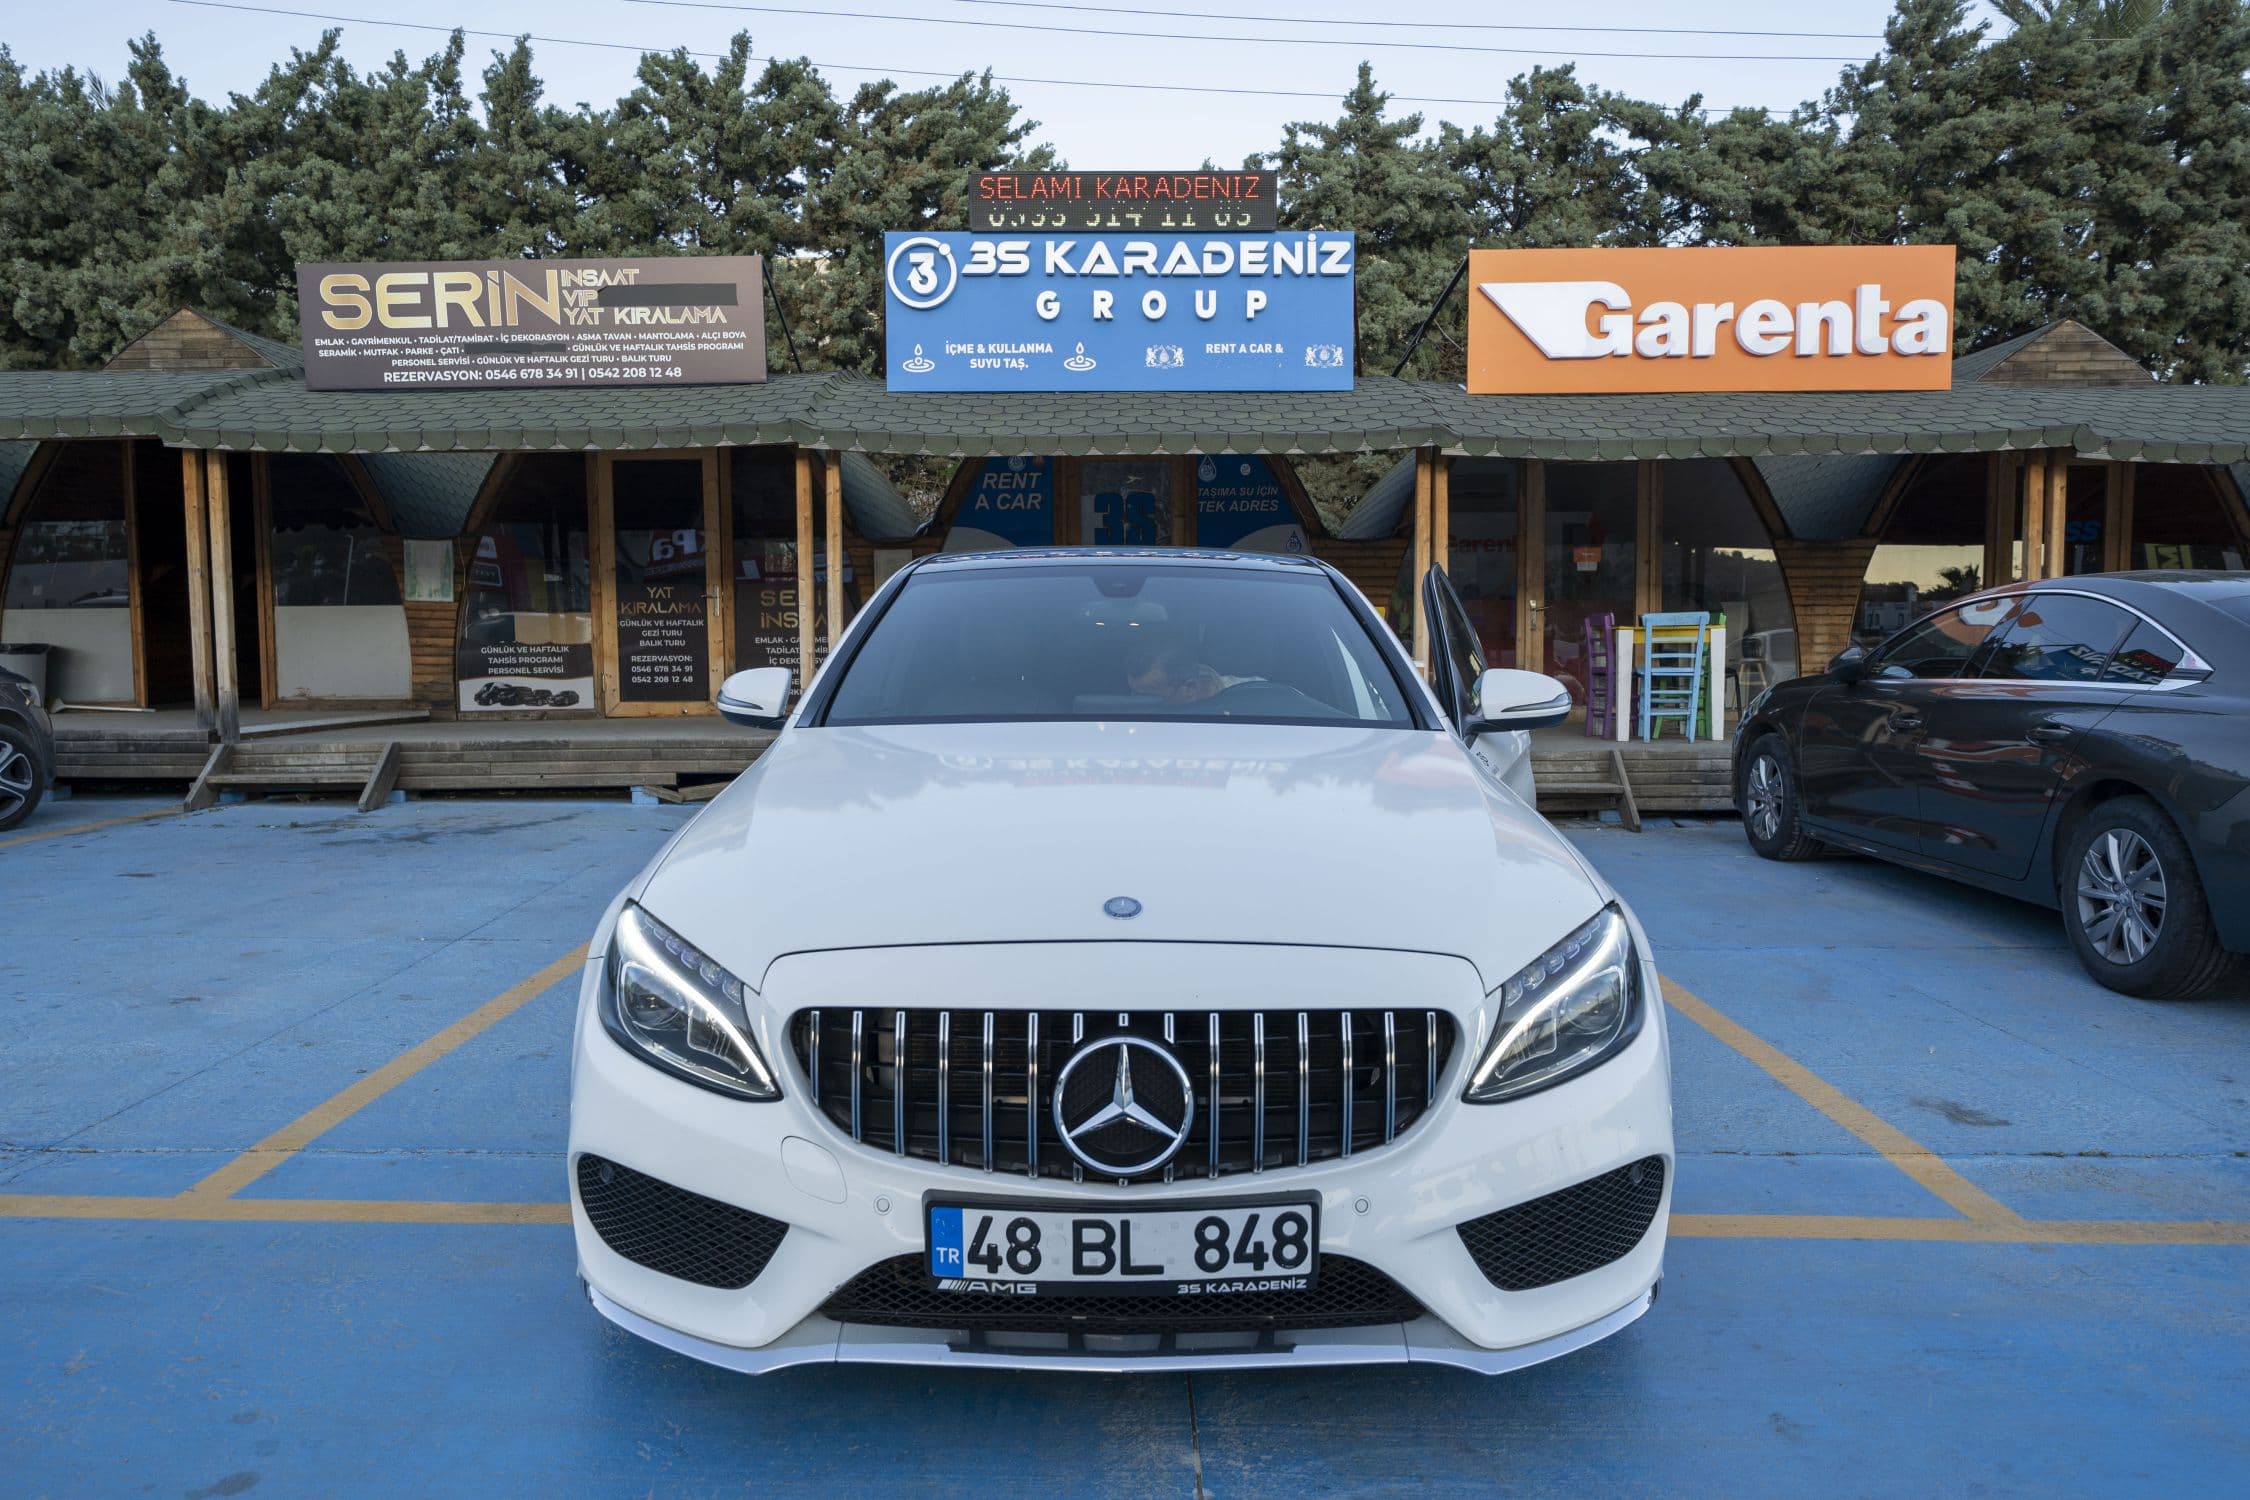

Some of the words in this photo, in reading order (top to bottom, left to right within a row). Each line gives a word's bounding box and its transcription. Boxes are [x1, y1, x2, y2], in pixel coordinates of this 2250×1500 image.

[961, 240, 1031, 276] 3S
[1045, 233, 1352, 276] KARADENİZ
[319, 268, 560, 330] SERİN
[1036, 289, 1268, 320] GROUP
[563, 307, 604, 325] YAT
[614, 306, 727, 325] KIRALAMA
[1478, 281, 1948, 358] Garenta
[315, 338, 345, 346] EMLAK
[351, 336, 412, 345] GAYRİMENKUL
[500, 333, 509, 343] İÇ
[511, 334, 570, 342] DEKORASYON
[576, 333, 602, 341] ASMA
[604, 333, 632, 341] TAVAN
[638, 332, 695, 340] MANTOLAMA
[701, 332, 721, 341] ALÇI
[722, 331, 746, 339] BOYA
[318, 348, 357, 357] SERAMİK
[364, 348, 399, 356] MUTFAK
[405, 347, 434, 355] PARKE
[440, 347, 460, 356] ÇATI
[572, 343, 607, 352] GÜNLÜK
[622, 343, 663, 351] HAFTALIK
[666, 342, 696, 351] TAHSİS
[698, 342, 744, 350] PROGRAMI
[945, 341, 974, 356] İÇME
[977, 343, 985, 354] &
[988, 343, 1053, 354] KULLANMA
[1205, 343, 1236, 354] RENT
[1239, 343, 1247, 354] A
[1249, 343, 1273, 354] CAR
[1274, 343, 1284, 354] &
[392, 358, 436, 366] PERSONEL
[438, 356, 470, 365] SERVİSİ
[477, 355, 512, 364] GÜNLÜK
[513, 356, 525, 364] VE
[527, 356, 568, 364] HAFTALIK
[570, 354, 589, 363] GEZİ
[649, 354, 672, 362] TURU
[969, 358, 1001, 369] SUYU
[384, 370, 483, 383] REZERVASYON:
[485, 369, 517, 380] 0546
[519, 368, 543, 379] 678
[546, 368, 563, 379] 34
[565, 368, 578, 379] 91
[588, 367, 620, 378] 0542
[622, 367, 647, 378] 208
[649, 367, 662, 378] 12
[665, 366, 682, 377] 48
[982, 472, 1042, 489] RENT
[1240, 487, 1254, 496] SU
[974, 494, 990, 510] A
[996, 493, 1042, 510] CAR
[1198, 500, 1225, 512] TEK
[1229, 500, 1280, 512] ADRES
[646, 586, 674, 599] YAT
[620, 601, 702, 614] KIRALAMA
[619, 619, 652, 627] GÜNLÜK
[666, 619, 704, 627] HAFTALIK
[641, 629, 660, 637] GEZİ
[664, 639, 686, 647] TURU
[481, 645, 515, 654] GÜNLÜK
[517, 646, 528, 654] VE
[530, 645, 570, 653] HAFTALIK
[488, 655, 517, 665] TAHSİS
[519, 656, 563, 664] PROGRAMI
[631, 655, 693, 663] REZERVASYON:
[769, 657, 778, 666] İÇ
[488, 667, 531, 675] PERSONEL
[533, 664, 564, 674] SERVİSİ
[684, 665, 693, 673] 91
[967, 1215, 1042, 1275] 48
[1072, 1218, 1164, 1276] BL
[1194, 1211, 1309, 1273] 848
[936, 1246, 960, 1265] TR
[967, 1279, 1037, 1295] AMG
[1177, 1284, 1201, 1295] 3S
[1205, 1276, 1308, 1294] KARADENİZ
